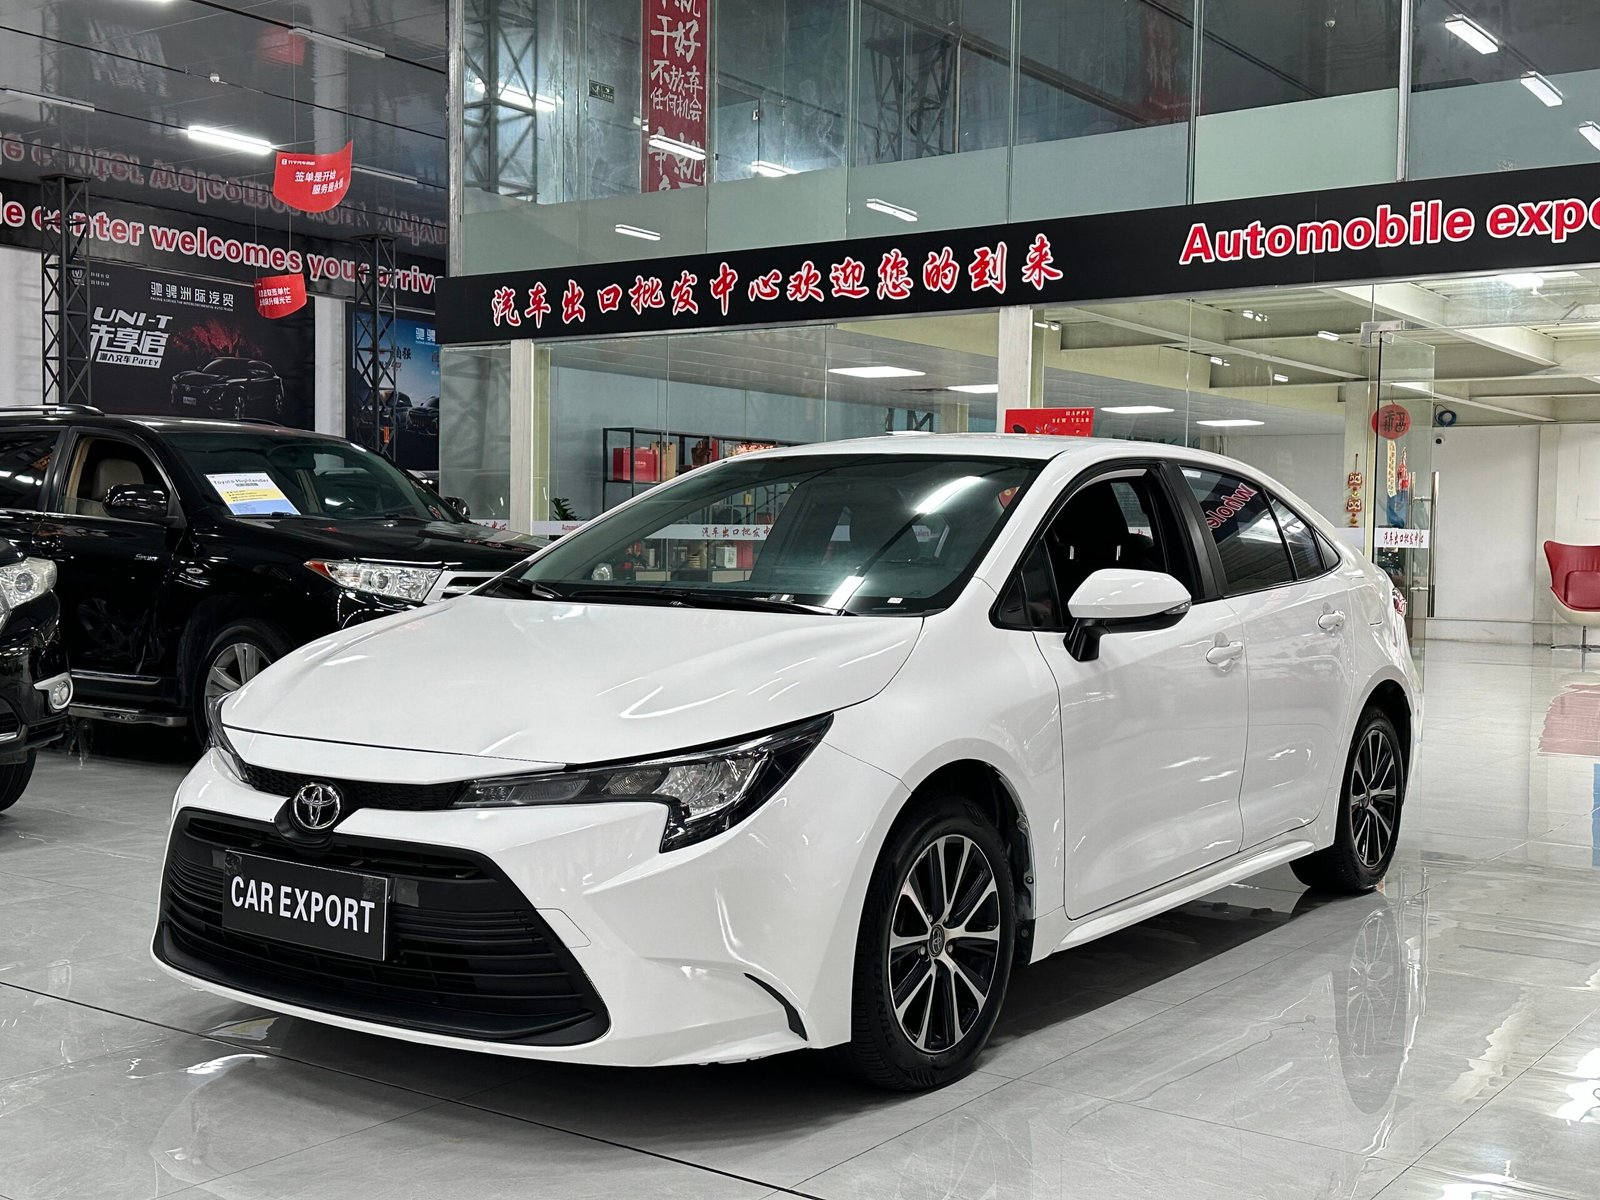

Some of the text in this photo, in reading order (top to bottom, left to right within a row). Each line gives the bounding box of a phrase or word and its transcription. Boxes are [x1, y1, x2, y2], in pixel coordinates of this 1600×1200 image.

[650, 59, 704, 100] 不放弃
[650, 86, 703, 123] 任何机会
[1179, 199, 1475, 265] Automobile
[149, 223, 303, 274] welcomes
[378, 265, 444, 294] arriv
[491, 233, 1064, 329] 汽车出口批发中心欢迎您的到来
[93, 306, 174, 329] UNI-T
[131, 356, 159, 367] Party
[230, 875, 376, 934] CAR EXPORT
